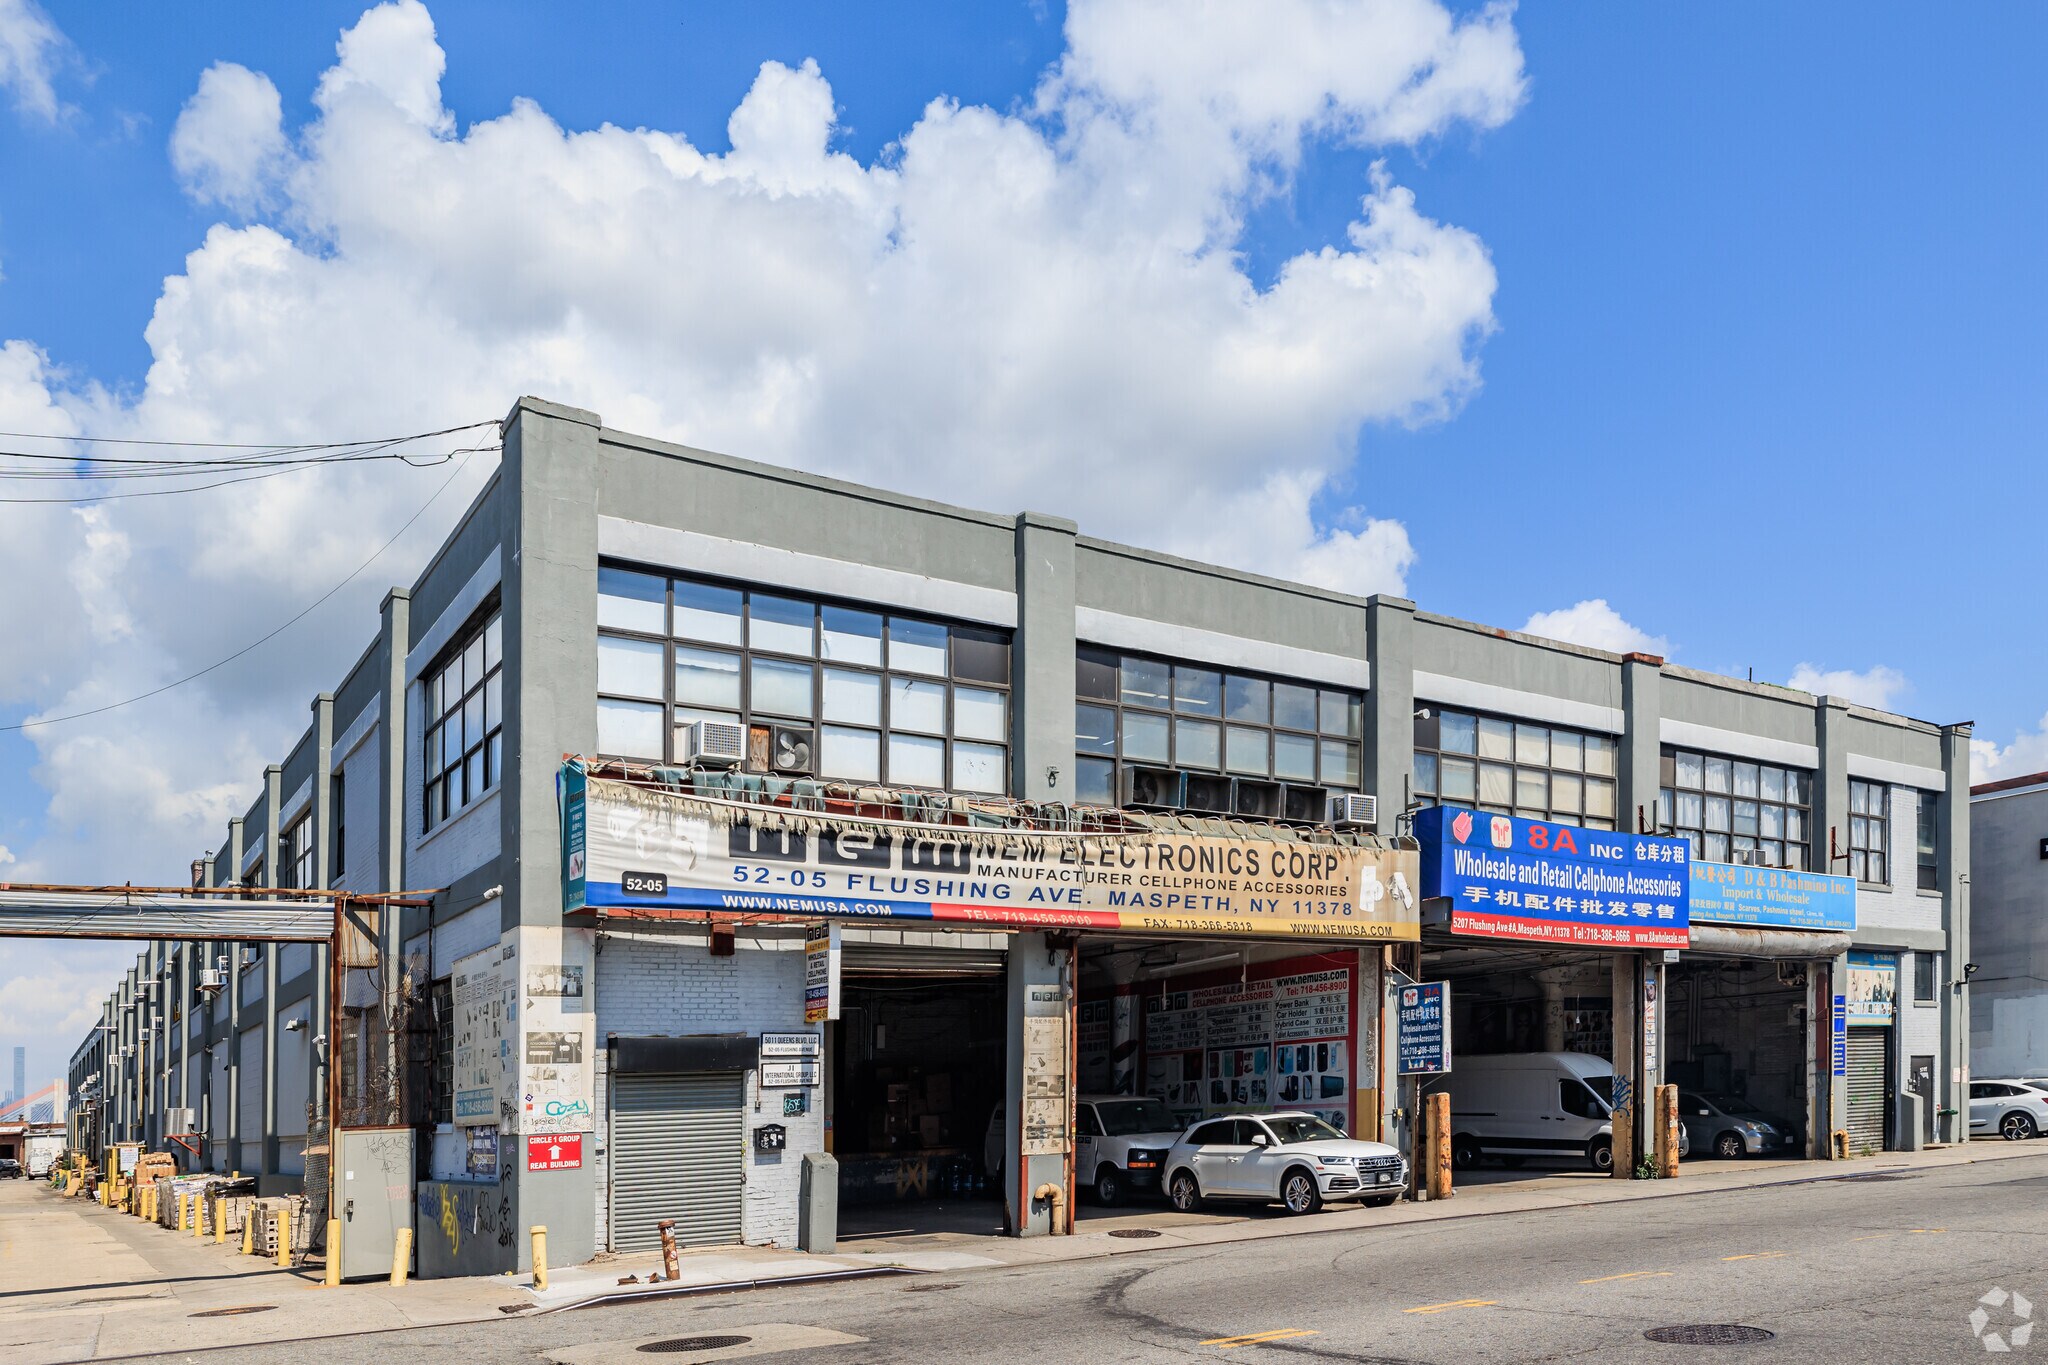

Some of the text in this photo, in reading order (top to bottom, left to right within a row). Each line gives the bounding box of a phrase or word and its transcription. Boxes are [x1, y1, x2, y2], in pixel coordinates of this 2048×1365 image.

[740, 820, 967, 870] nem
[1528, 825, 1624, 859] 8A INC
[976, 838, 1045, 863] NEM
[1059, 840, 1260, 877] ELECTRONICS
[1634, 841, 1685, 863] 仓库分租
[977, 864, 1347, 897] MANUFACTURER CELLPHONE ACCESSORIES
[1454, 849, 1681, 897] Wholesale and Retail Cellphone Accessories
[626, 877, 663, 893] 52-05
[1756, 871, 1766, 886] &
[1770, 872, 1777, 888] B
[1781, 873, 1828, 892] Pashmina
[733, 865, 1352, 916] 52-05 FLUSHING AVE. MASPETH, NY 11378
[1722, 885, 1810, 904] Import & Wholesale
[722, 894, 893, 916] WWW.NEMUSA.COM
[1462, 886, 1676, 919] 手机配件批发零售
[963, 909, 1093, 926] TEL: 718-456-8900
[1144, 918, 1173, 930] FAX:
[1453, 917, 1469, 929] 5207
[1469, 918, 1495, 933] Flushing
[1496, 920, 1508, 932] Ave
[807, 925, 829, 941] nem
[1290, 923, 1393, 937] WWW.NEMUSA.COM
[1635, 931, 1688, 944] www.8Awholesale.com
[808, 951, 827, 961] WHOLESALE
[807, 968, 827, 978] CELLPHONE
[813, 961, 825, 969] RETAIL
[806, 975, 828, 986] ACCESSORIES
[1276, 970, 1348, 987] www.nemusa.com
[1192, 985, 1235, 999] WHOLESALE
[1245, 981, 1274, 991] RETAIL
[1286, 980, 1348, 996] Tel: 718-456-8900
[1424, 987, 1440, 997] 8A
[1192, 990, 1274, 1008] CELLPHONE ACCESSORIES
[1288, 1009, 1307, 1017] Holder
[1275, 1020, 1293, 1030] Hybrid
[1402, 1024, 1421, 1033] Wholesale
[1428, 1022, 1440, 1031] Retail
[1401, 1034, 1441, 1046] Cellphone Accessories
[529, 1136, 552, 1144] CIRCLE
[558, 1135, 580, 1143] GROUP
[530, 1160, 580, 1170] REAR BUILDING
